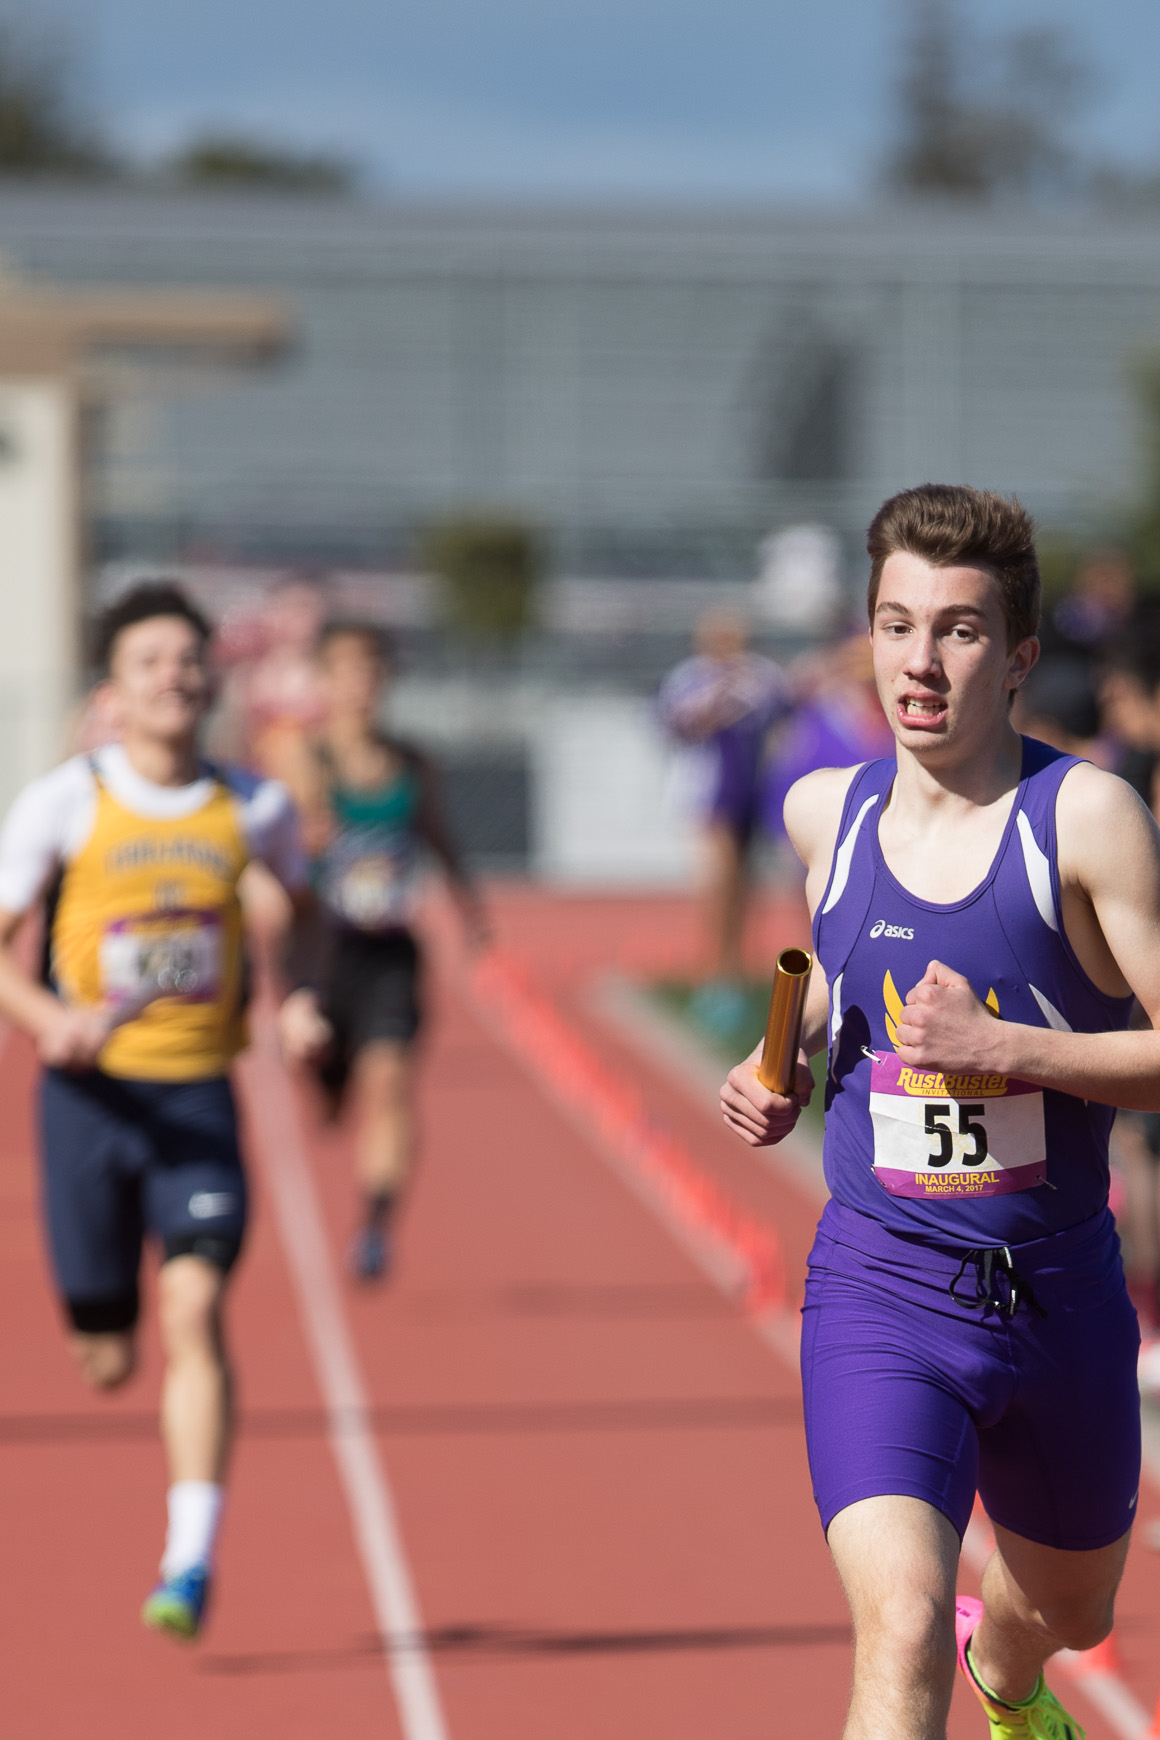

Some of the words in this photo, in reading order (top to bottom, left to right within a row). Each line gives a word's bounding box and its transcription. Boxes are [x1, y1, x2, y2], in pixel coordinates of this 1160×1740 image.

[884, 925, 914, 940] asics
[897, 1068, 1008, 1090] RustBuster
[924, 1104, 988, 1168] 55
[916, 1172, 999, 1186] INAUGURAL
[925, 1185, 956, 1193] MARCH
[956, 1185, 964, 1193] 4,
[965, 1184, 984, 1193] 2017
